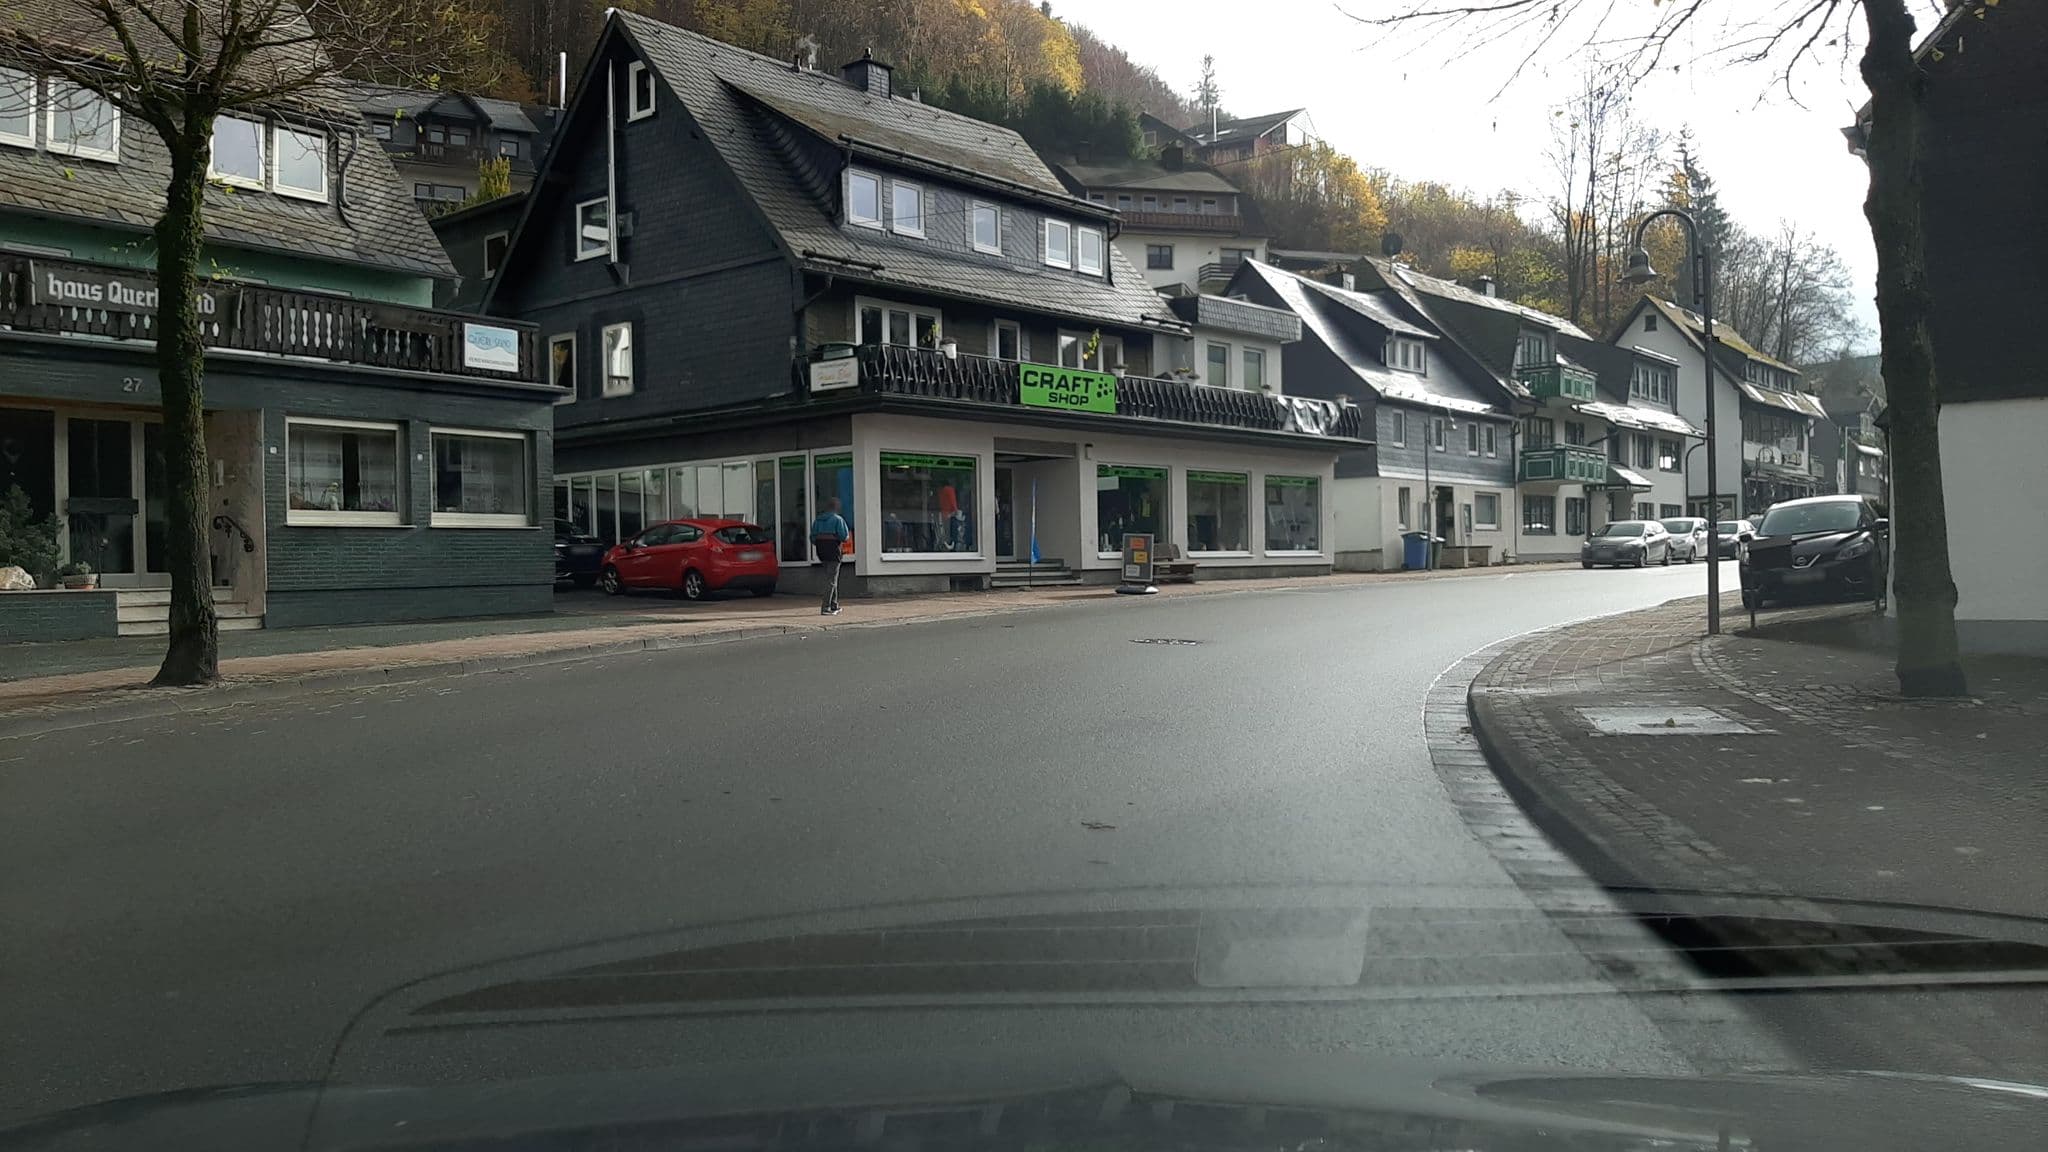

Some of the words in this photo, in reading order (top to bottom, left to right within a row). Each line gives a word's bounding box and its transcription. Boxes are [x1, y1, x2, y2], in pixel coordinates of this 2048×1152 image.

[123, 377, 143, 392] 27
[1023, 370, 1094, 393] CRAFT
[1048, 391, 1089, 406] SHOP
